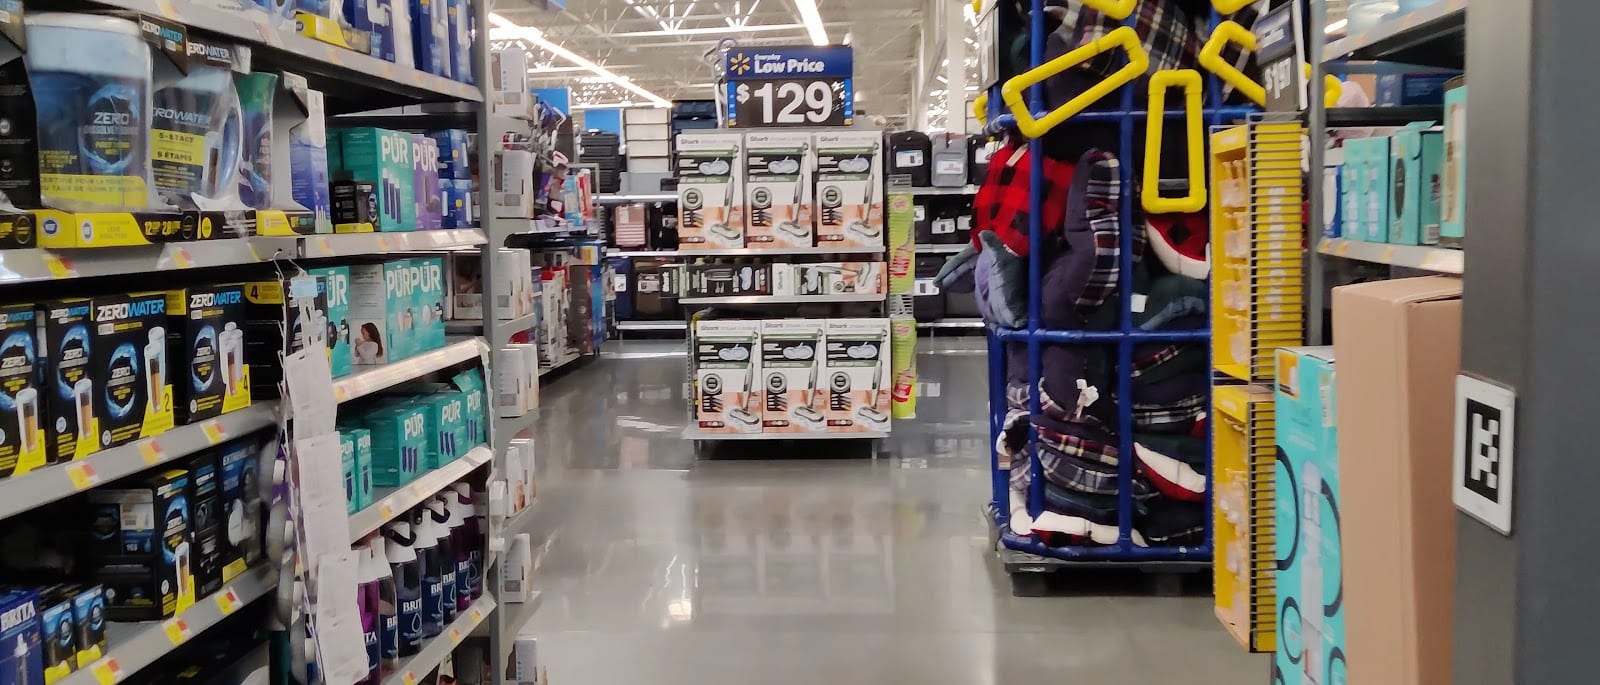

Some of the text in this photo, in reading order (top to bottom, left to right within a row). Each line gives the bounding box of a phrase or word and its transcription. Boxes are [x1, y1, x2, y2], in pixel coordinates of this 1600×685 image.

[754, 58, 825, 73] Low Price
[736, 81, 833, 123] $129
[94, 112, 129, 124] ZERO
[190, 291, 241, 308] ZEROWATER
[250, 285, 259, 300] 4
[97, 299, 165, 321] ZEROWATER
[63, 348, 83, 360] ZERO
[1, 356, 26, 368] ZERO
[112, 366, 131, 378] ZERO
[243, 375, 248, 391] 4
[164, 393, 170, 412] 2
[403, 598, 421, 612] BRIT
[0, 601, 36, 632] BRITA
